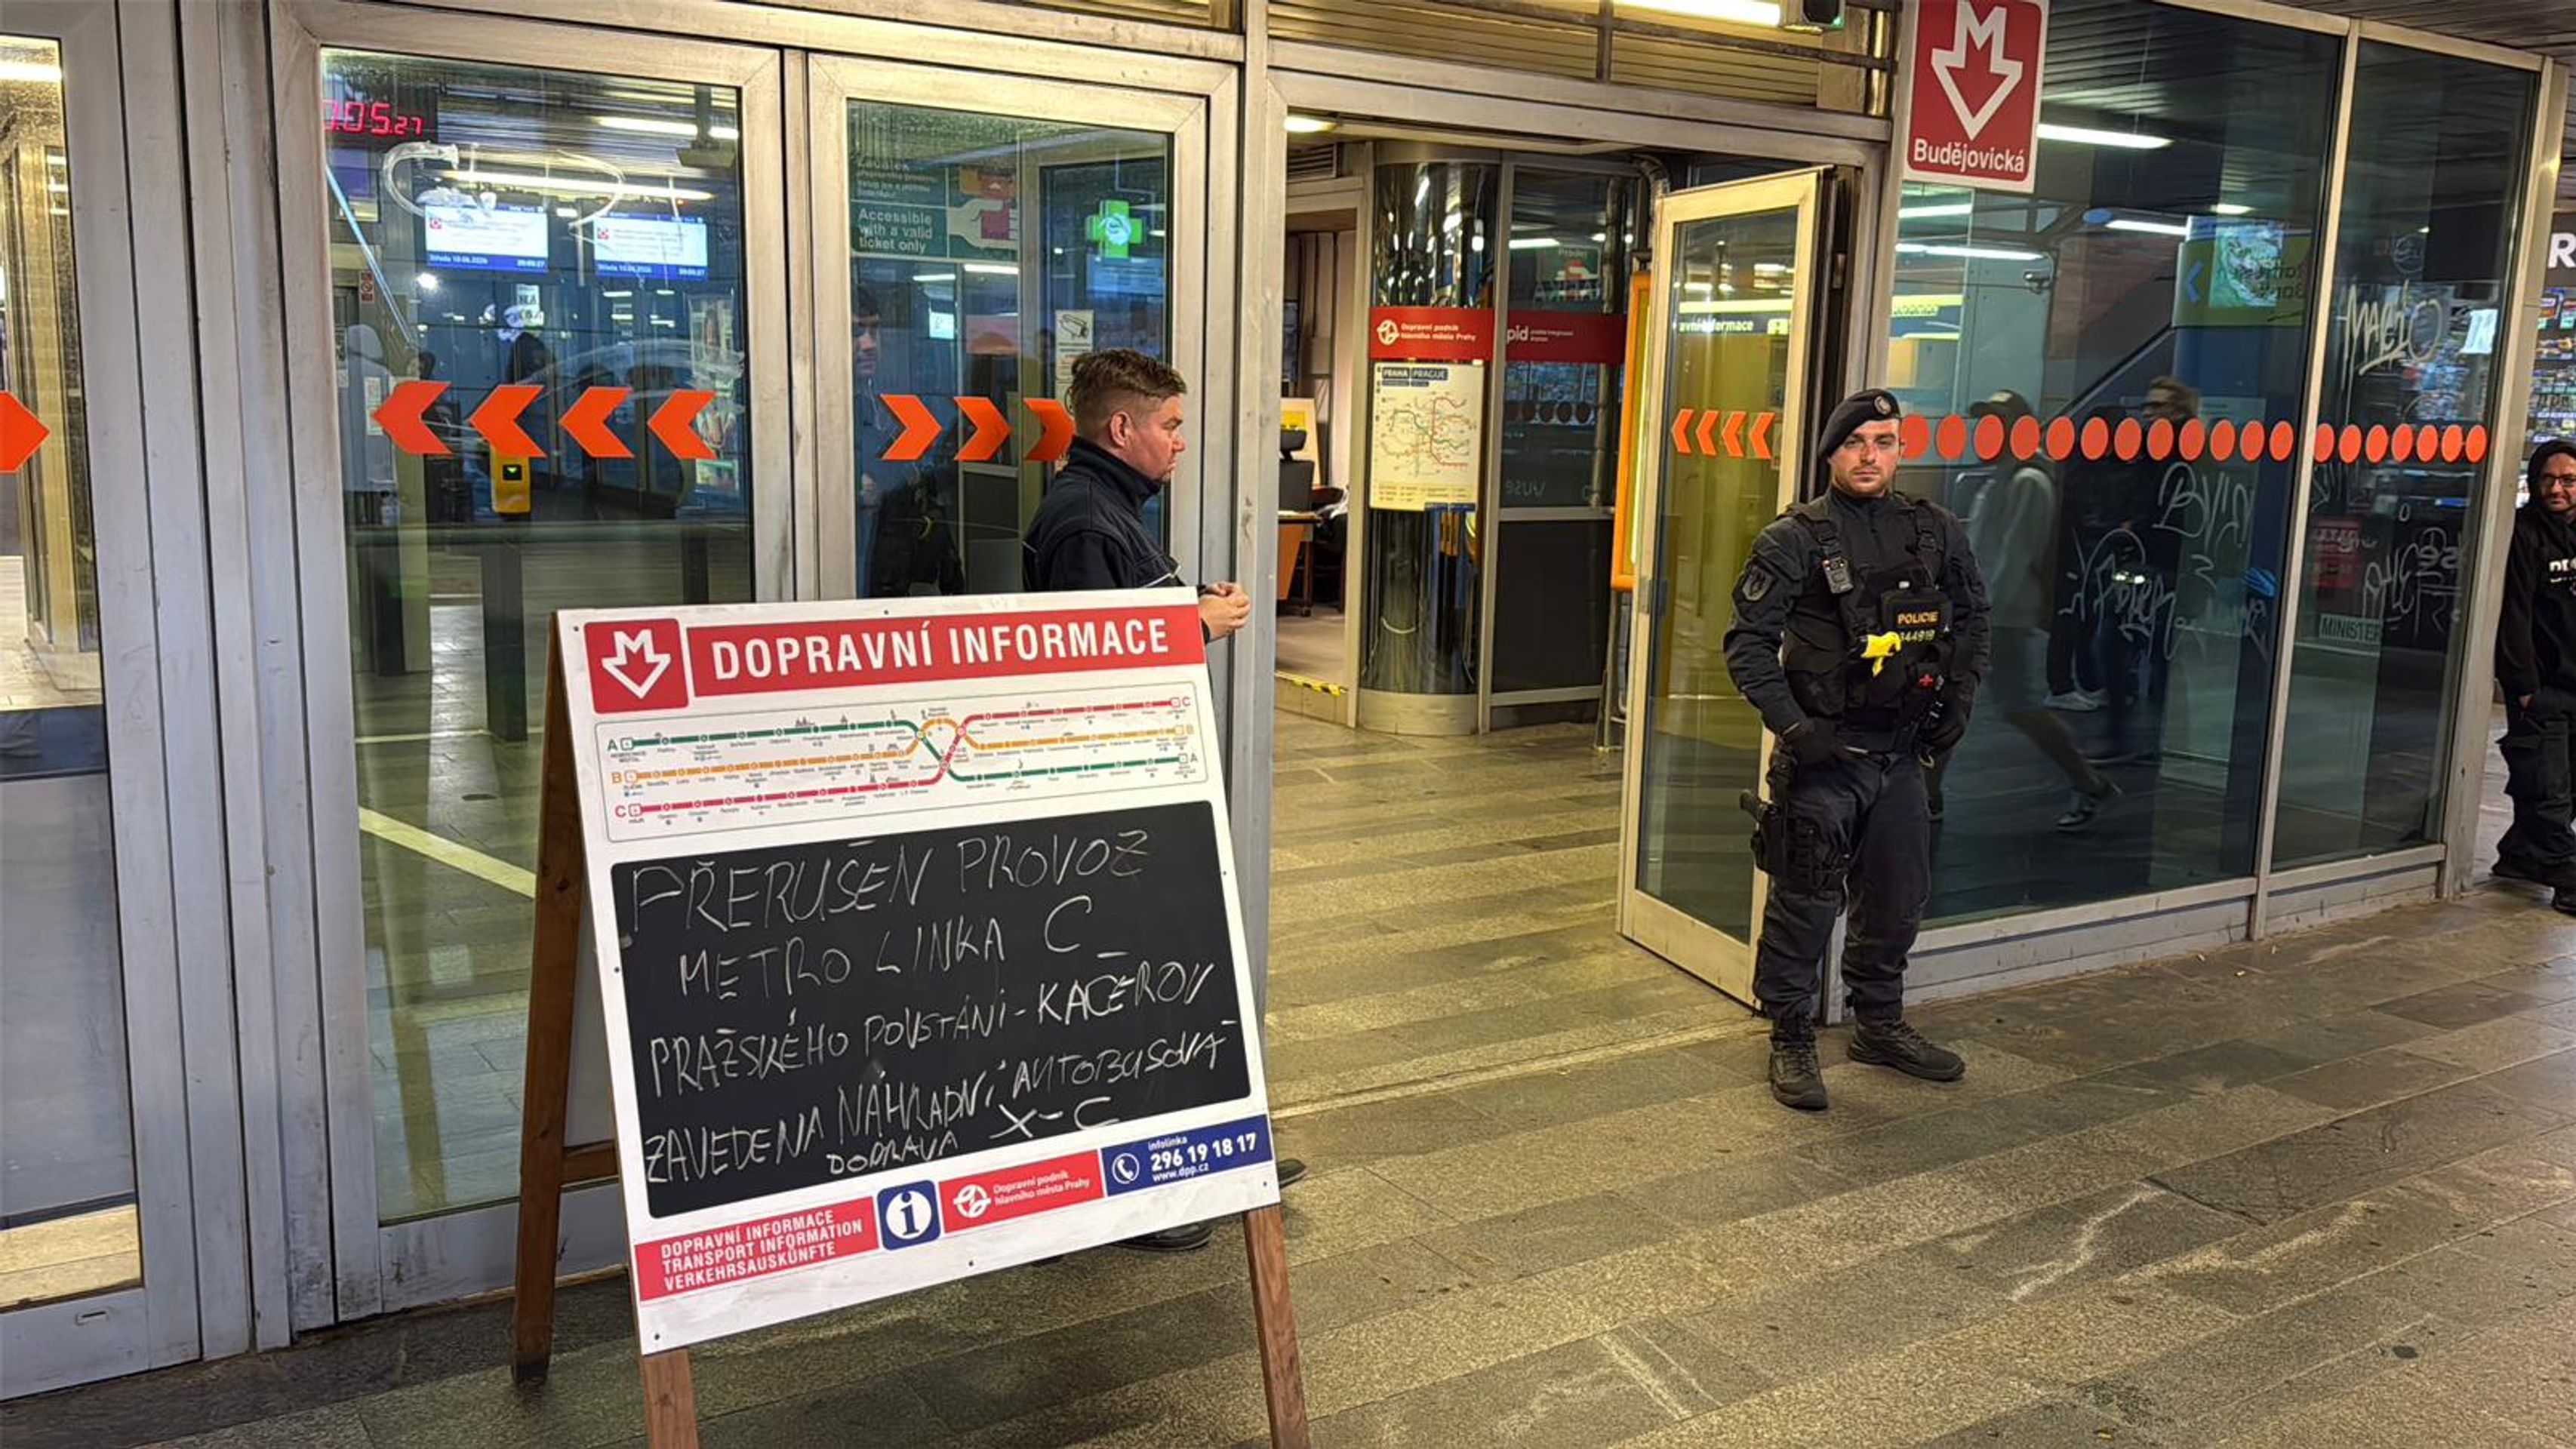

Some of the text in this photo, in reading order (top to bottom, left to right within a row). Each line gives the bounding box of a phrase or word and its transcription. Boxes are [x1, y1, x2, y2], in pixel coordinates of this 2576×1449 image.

[1914, 138, 2025, 173] Budějovická
[858, 208, 932, 225] Accessible
[859, 223, 933, 239] with a valid
[859, 236, 927, 254] ticket only
[1897, 611, 1939, 625] POLICIE
[712, 618, 1169, 681] DOPRAVNÍ INFORMACE
[632, 829, 1150, 933] PŘERUŠEN PROVOZ
[680, 936, 851, 999] METRO
[876, 915, 1005, 974] LINKA
[649, 1007, 849, 1098] PRAŽSKÉHO
[645, 1106, 824, 1183] ZAVEDENA
[826, 1129, 959, 1175] DOPRAVA
[1148, 1135, 1187, 1151] infolinka
[1150, 1133, 1257, 1171] 296 19 18 17
[993, 1171, 1069, 1194] Dopravní podnik
[1152, 1162, 1209, 1182] www.dpp.cz
[994, 1178, 1090, 1206] hlavního města Prahy
[661, 1210, 835, 1259] DOPRAVNÍ INFORMACE
[663, 1219, 863, 1275] TRANSPORT INFORMATION
[664, 1241, 836, 1292] VERKEHRSAUSKÜNFTE
